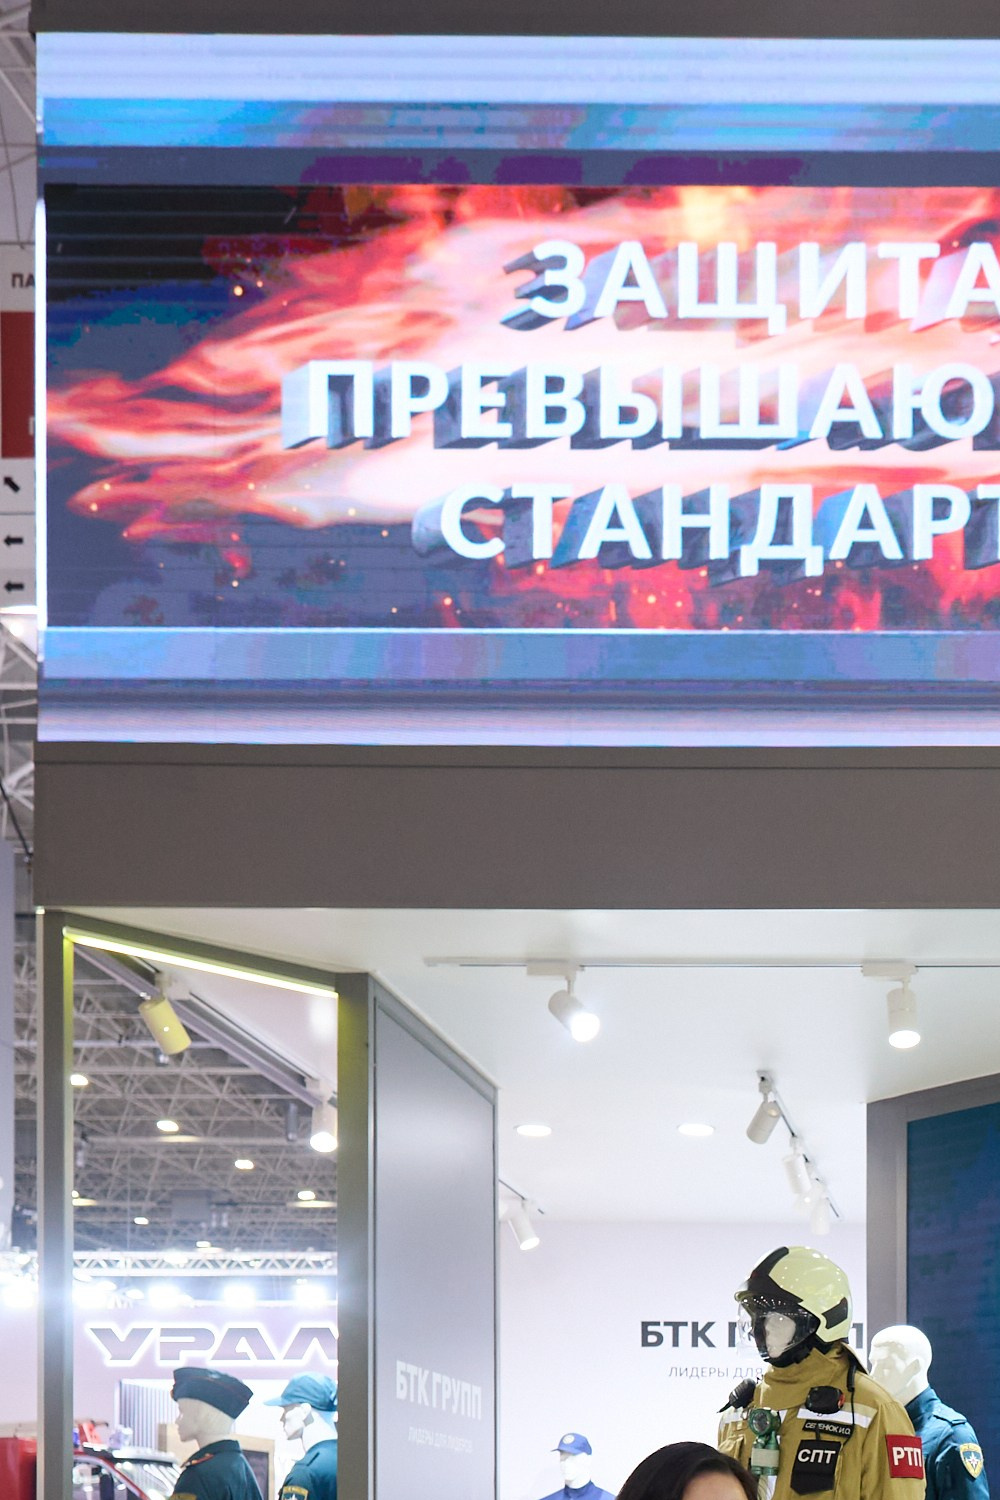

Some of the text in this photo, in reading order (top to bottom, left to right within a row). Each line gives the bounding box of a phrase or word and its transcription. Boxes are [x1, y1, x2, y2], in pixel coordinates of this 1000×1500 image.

[87, 1326, 338, 1362] УРАЛ
[640, 1320, 716, 1348] БТК
[667, 1366, 764, 1380] ЛИДЕРЫ ДЛЯ
[396, 1360, 482, 1421] БТК ГРУПП
[797, 1448, 836, 1464] СПТ
[892, 1446, 922, 1467] РТП
